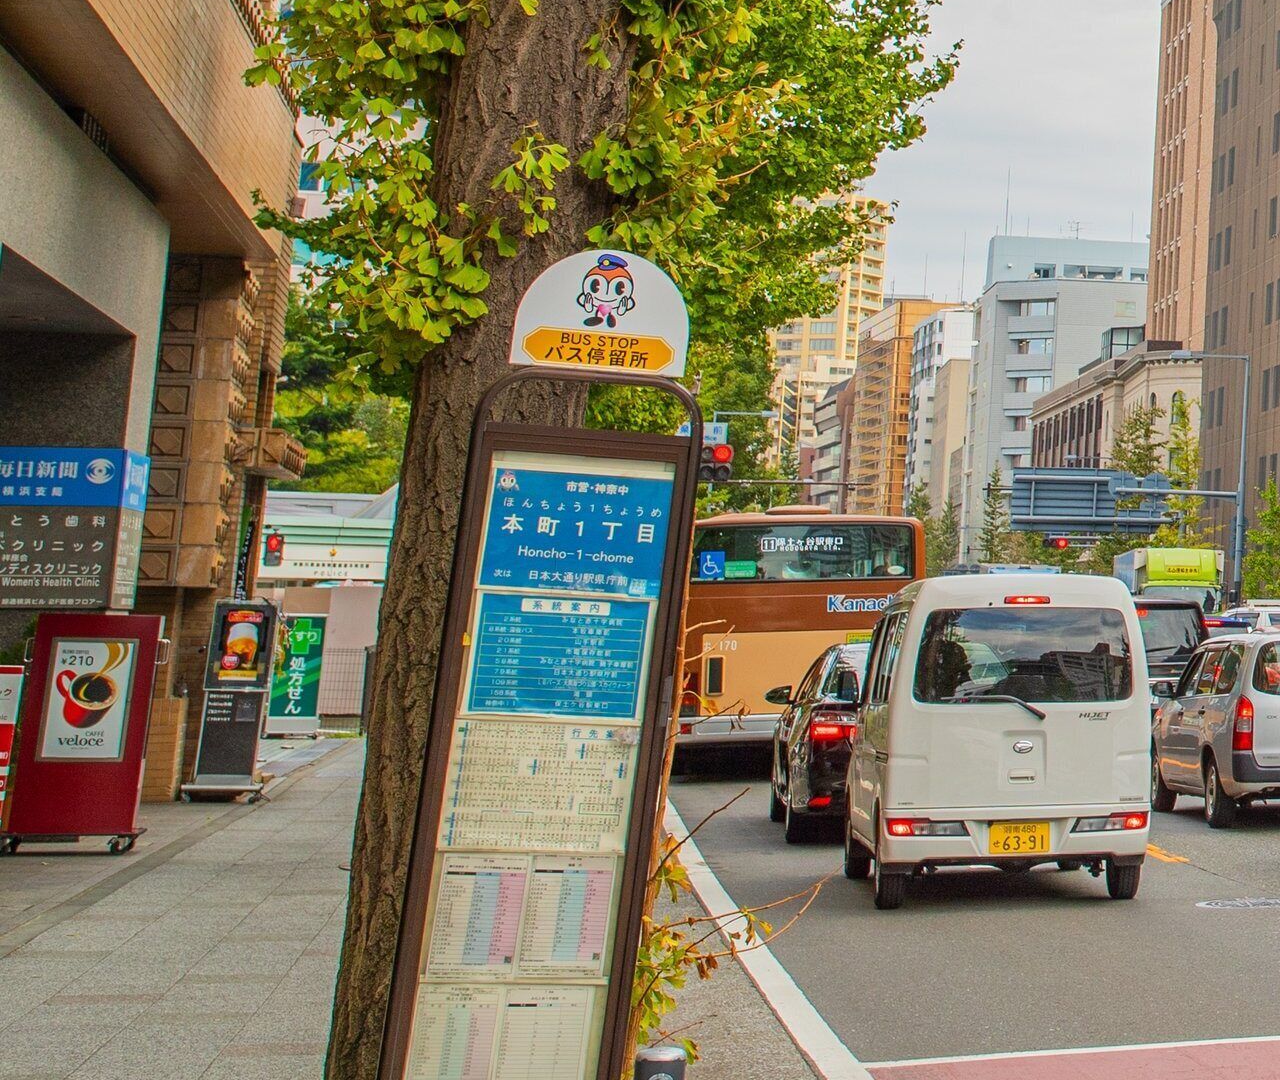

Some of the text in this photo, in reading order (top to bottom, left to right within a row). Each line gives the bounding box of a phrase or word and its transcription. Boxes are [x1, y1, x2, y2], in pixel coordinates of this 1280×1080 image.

[561, 332, 639, 349] BUS STOP
[545, 345, 649, 369] バス停留所
[0, 460, 79, 479] 毎日新聞
[2, 486, 63, 497] 横浜支局
[566, 481, 629, 496] 市営・神奈中
[501, 513, 656, 543] 本町1丁目
[764, 539, 775, 550] 11
[517, 545, 634, 564] Honcho-1-chome
[493, 569, 512, 578] 次は
[2, 576, 101, 587] Women's Health Clinic
[531, 600, 600, 613] 系統案内
[720, 640, 737, 651] 170
[284, 656, 306, 715] 処方せん
[58, 734, 104, 746] veloce
[1002, 834, 1044, 851] 63-91
